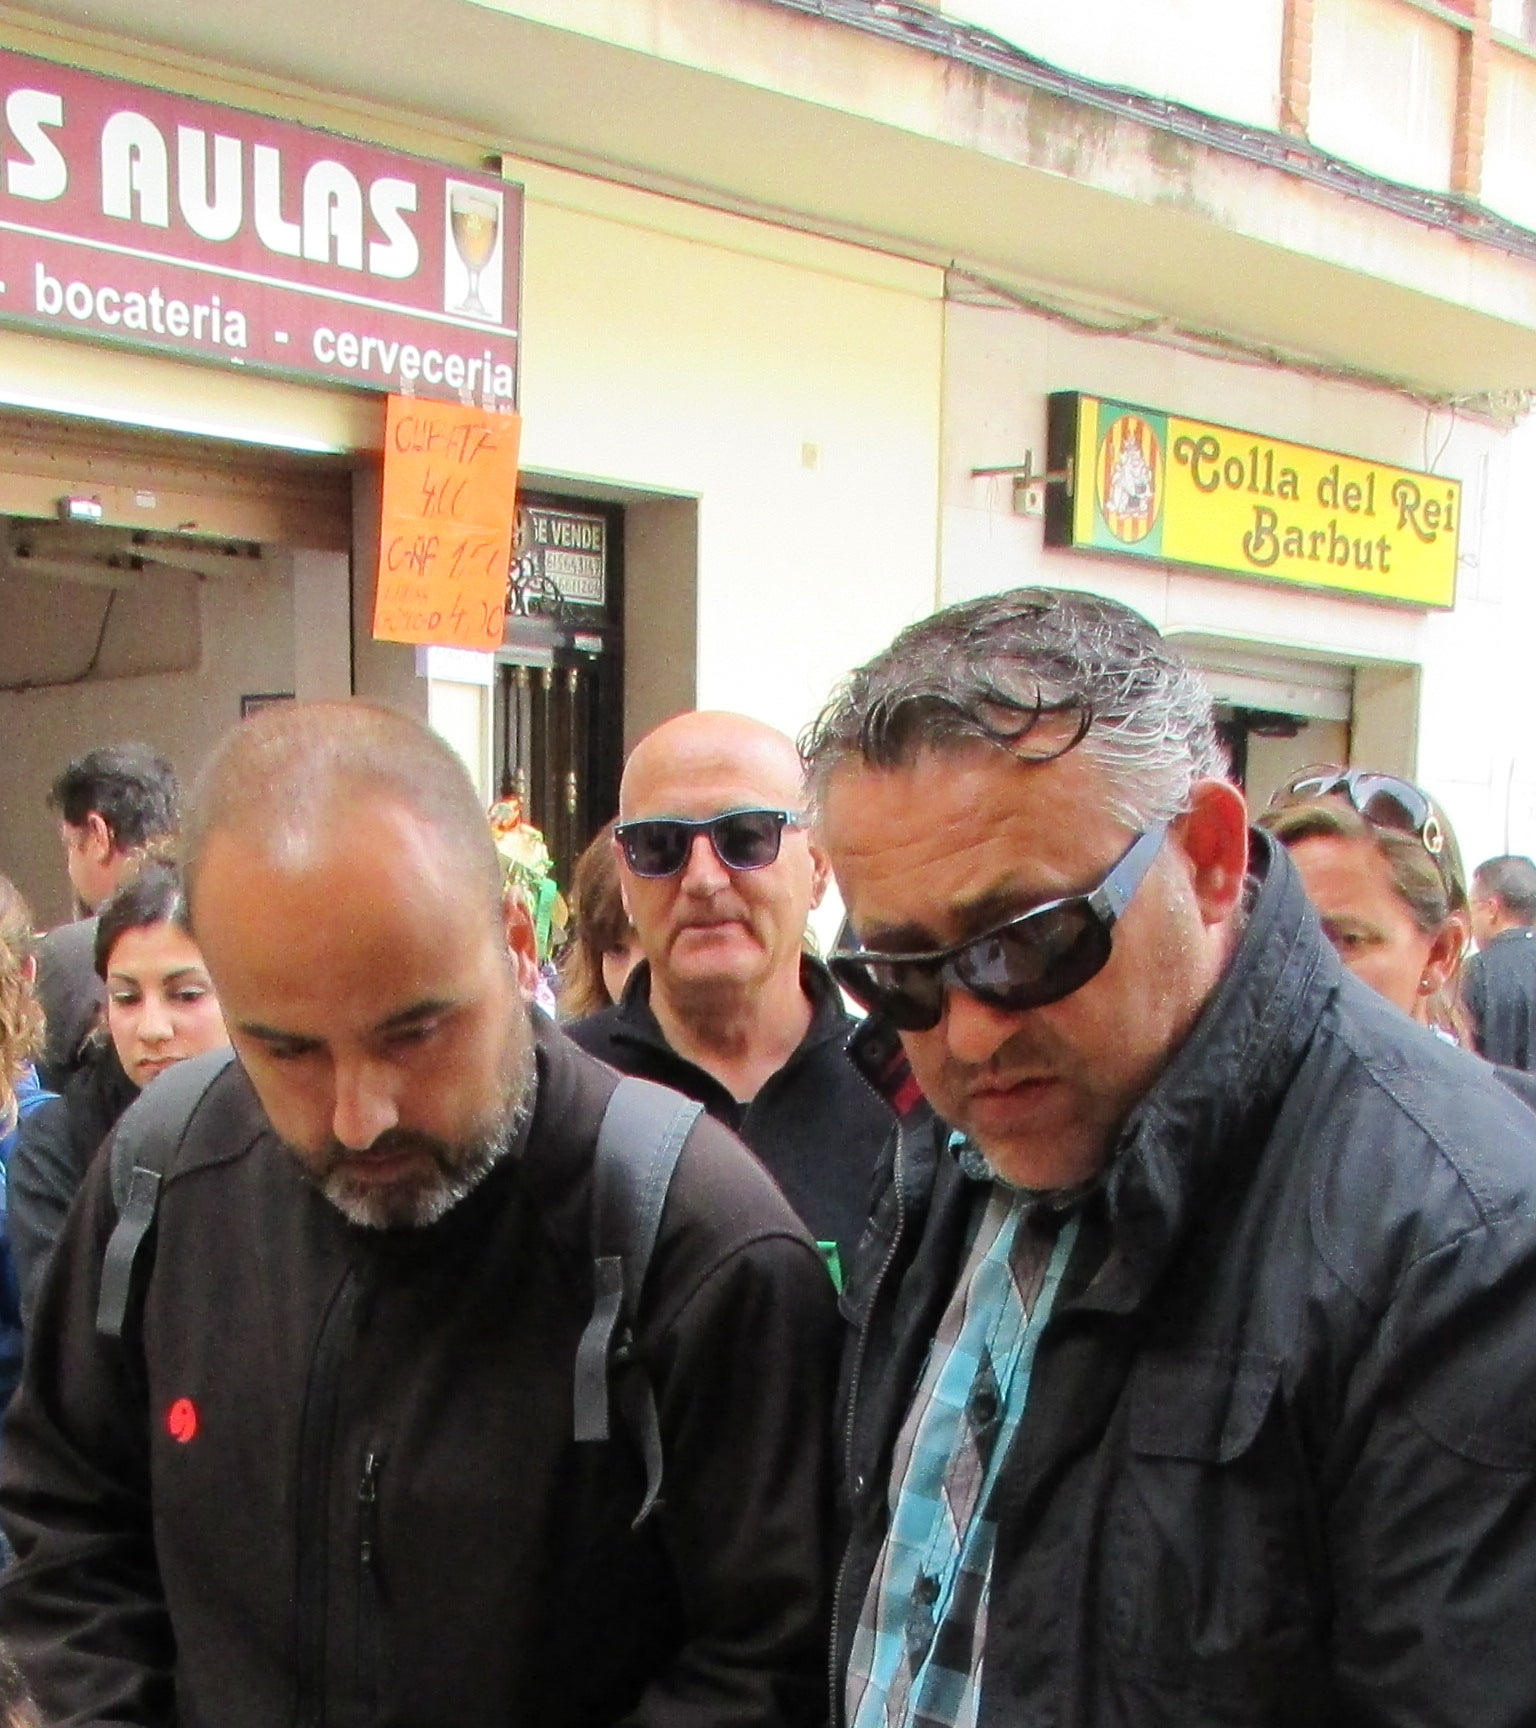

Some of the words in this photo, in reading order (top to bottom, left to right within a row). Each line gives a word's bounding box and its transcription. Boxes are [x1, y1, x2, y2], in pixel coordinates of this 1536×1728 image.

[101, 109, 420, 280] AULAS
[34, 263, 248, 349] bocateria
[312, 326, 514, 398] cerveceria
[550, 519, 602, 552] VENDE
[1173, 434, 1301, 502] Colla
[1317, 463, 1375, 516] del
[1391, 478, 1456, 544] Rei
[1242, 504, 1392, 574] Barbut
